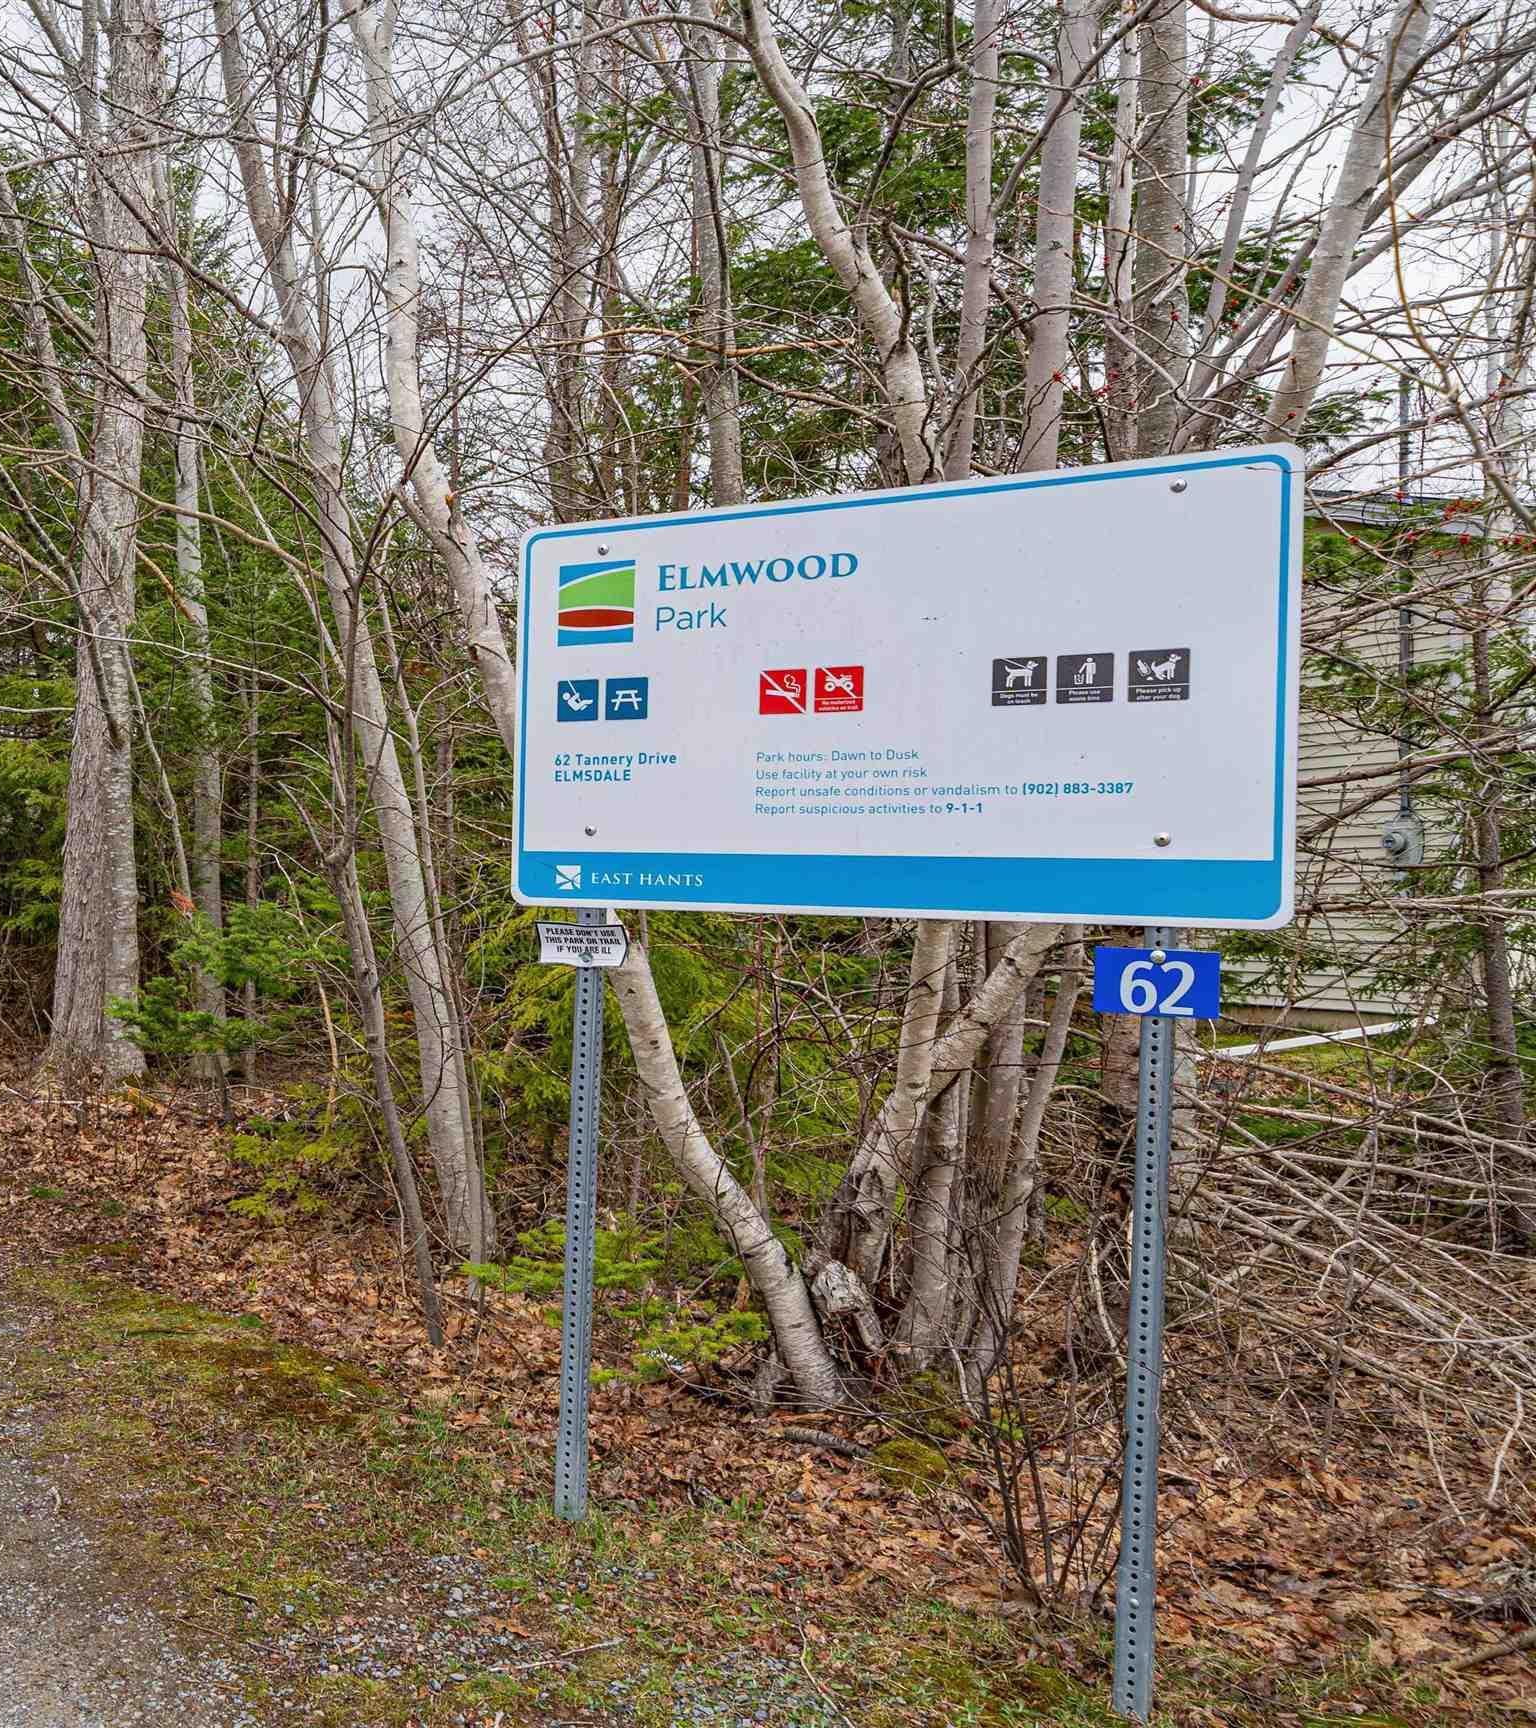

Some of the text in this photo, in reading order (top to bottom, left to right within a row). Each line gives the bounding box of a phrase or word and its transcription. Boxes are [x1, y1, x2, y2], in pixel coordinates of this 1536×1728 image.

[657, 552, 859, 592] ELMWOOD
[655, 602, 727, 632] Park
[554, 752, 678, 767] 62 Tannery Drive
[755, 751, 785, 763] Park
[831, 750, 866, 761] Dawn
[870, 750, 882, 761] to
[885, 749, 920, 761] Dusk
[554, 769, 632, 782] ELMSDALE
[755, 768, 928, 782] Use facility at your own risk
[755, 786, 796, 800] Report
[799, 785, 841, 797] unsafe
[844, 785, 910, 797] conditions
[913, 786, 928, 796] or
[931, 784, 1001, 796] vandalism
[1005, 784, 1018, 795] to
[1063, 782, 1135, 795] 883-3387
[755, 802, 984, 817] Report suspicious activities to 9-1-1
[591, 872, 704, 887] EAST HANTS
[546, 927, 574, 936] PLEASE
[545, 936, 563, 944] THIS
[564, 936, 585, 945] PARK
[556, 945, 565, 953] IF
[566, 945, 582, 953] YOU
[584, 945, 599, 954] ARE
[1120, 960, 1196, 1016] 62
